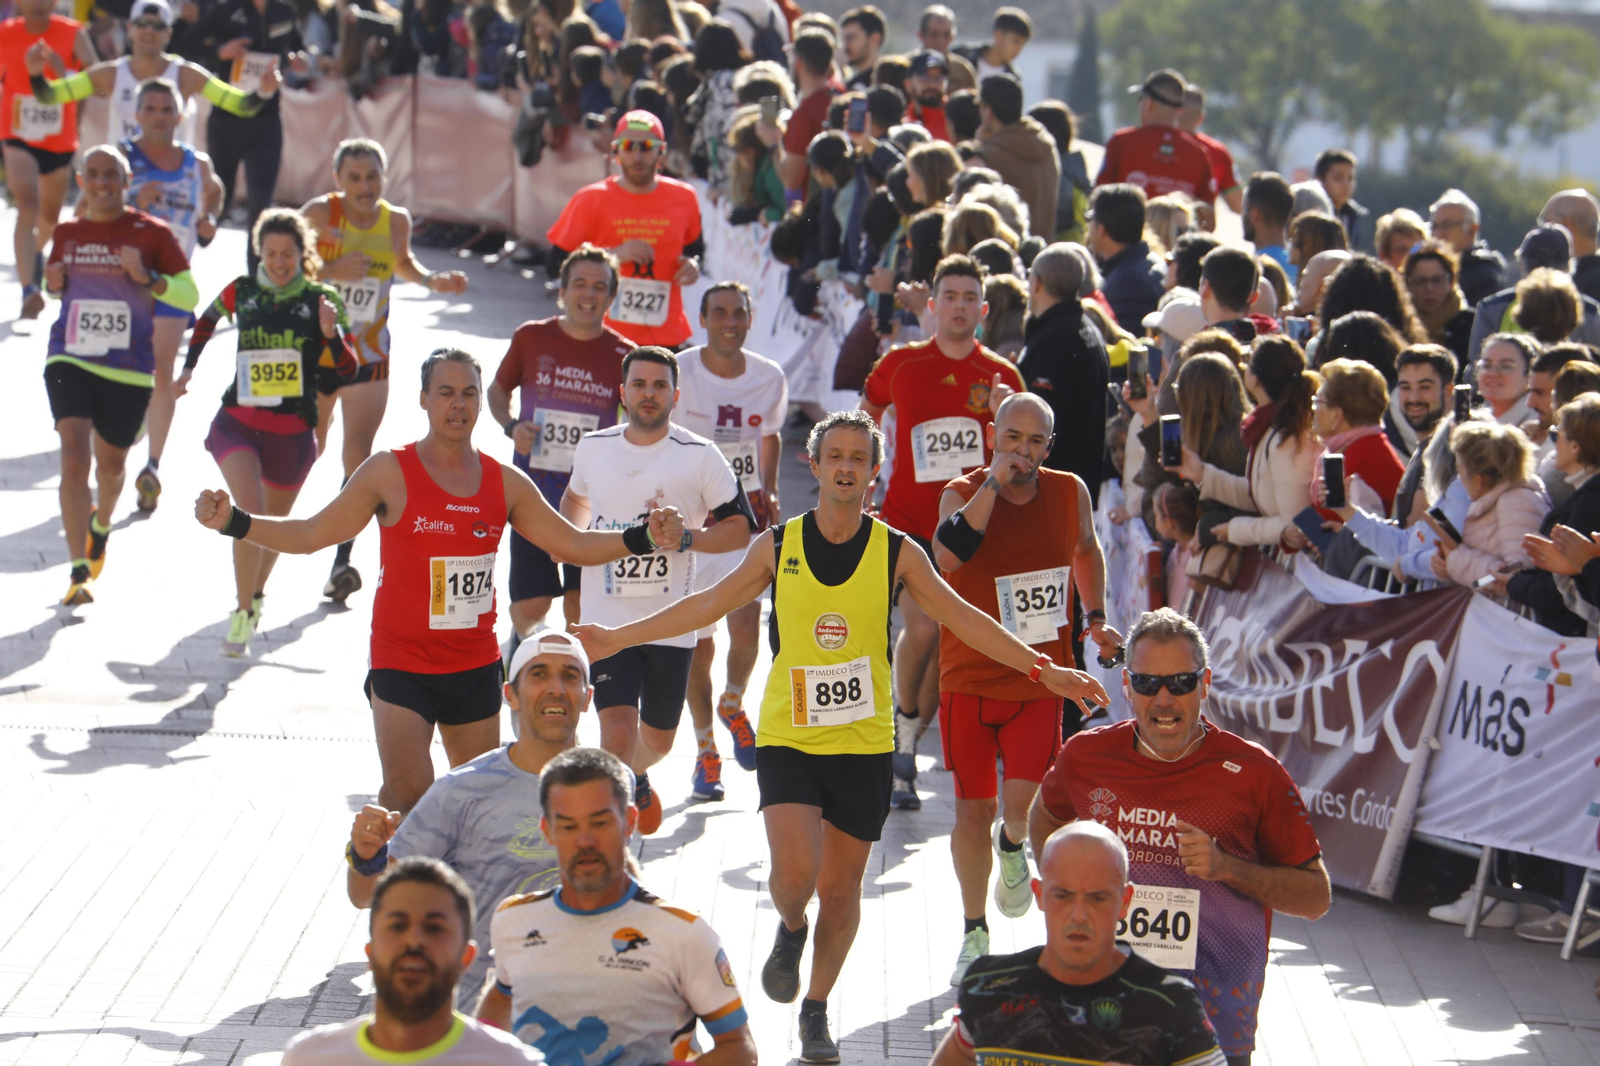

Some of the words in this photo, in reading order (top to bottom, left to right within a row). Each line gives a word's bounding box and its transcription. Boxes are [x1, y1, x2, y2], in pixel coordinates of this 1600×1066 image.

[622, 290, 666, 311] 3227
[79, 311, 127, 332] 5235
[251, 362, 298, 382] 3952
[555, 366, 593, 382] MEDIA
[535, 372, 551, 386] 36
[554, 378, 613, 398] MARATÓN
[926, 429, 979, 453] 2942
[728, 455, 754, 476] 98
[423, 520, 455, 531] califas
[455, 559, 483, 567] IMDECO
[614, 554, 669, 579] 3273
[448, 568, 493, 596] 1874
[1020, 572, 1050, 583] IMDECO
[1014, 581, 1064, 613] 3521
[815, 667, 848, 677] IMDECO
[815, 676, 862, 707] 898
[1117, 805, 1178, 829] MEDIA
[1127, 848, 1180, 867] ÓRDOBA
[1153, 942, 1183, 950] CABALLERO
